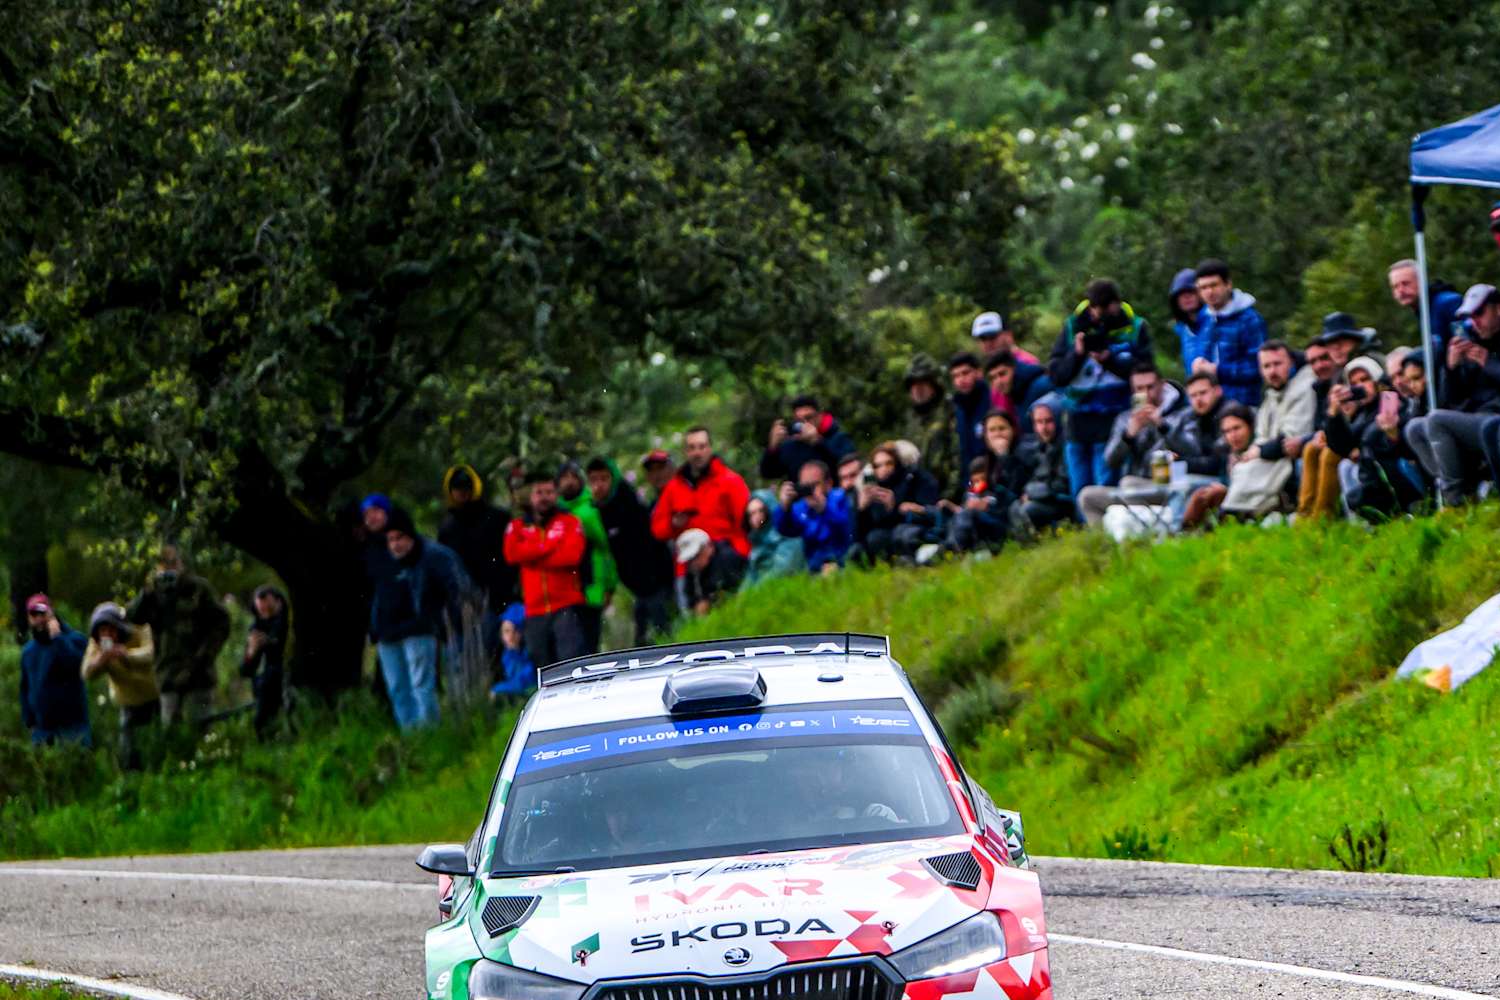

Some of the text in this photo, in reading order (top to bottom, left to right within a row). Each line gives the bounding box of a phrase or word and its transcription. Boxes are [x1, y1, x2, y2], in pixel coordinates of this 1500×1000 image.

[618, 725, 729, 746] FOLLOW US ON
[634, 877, 825, 912] IVAR
